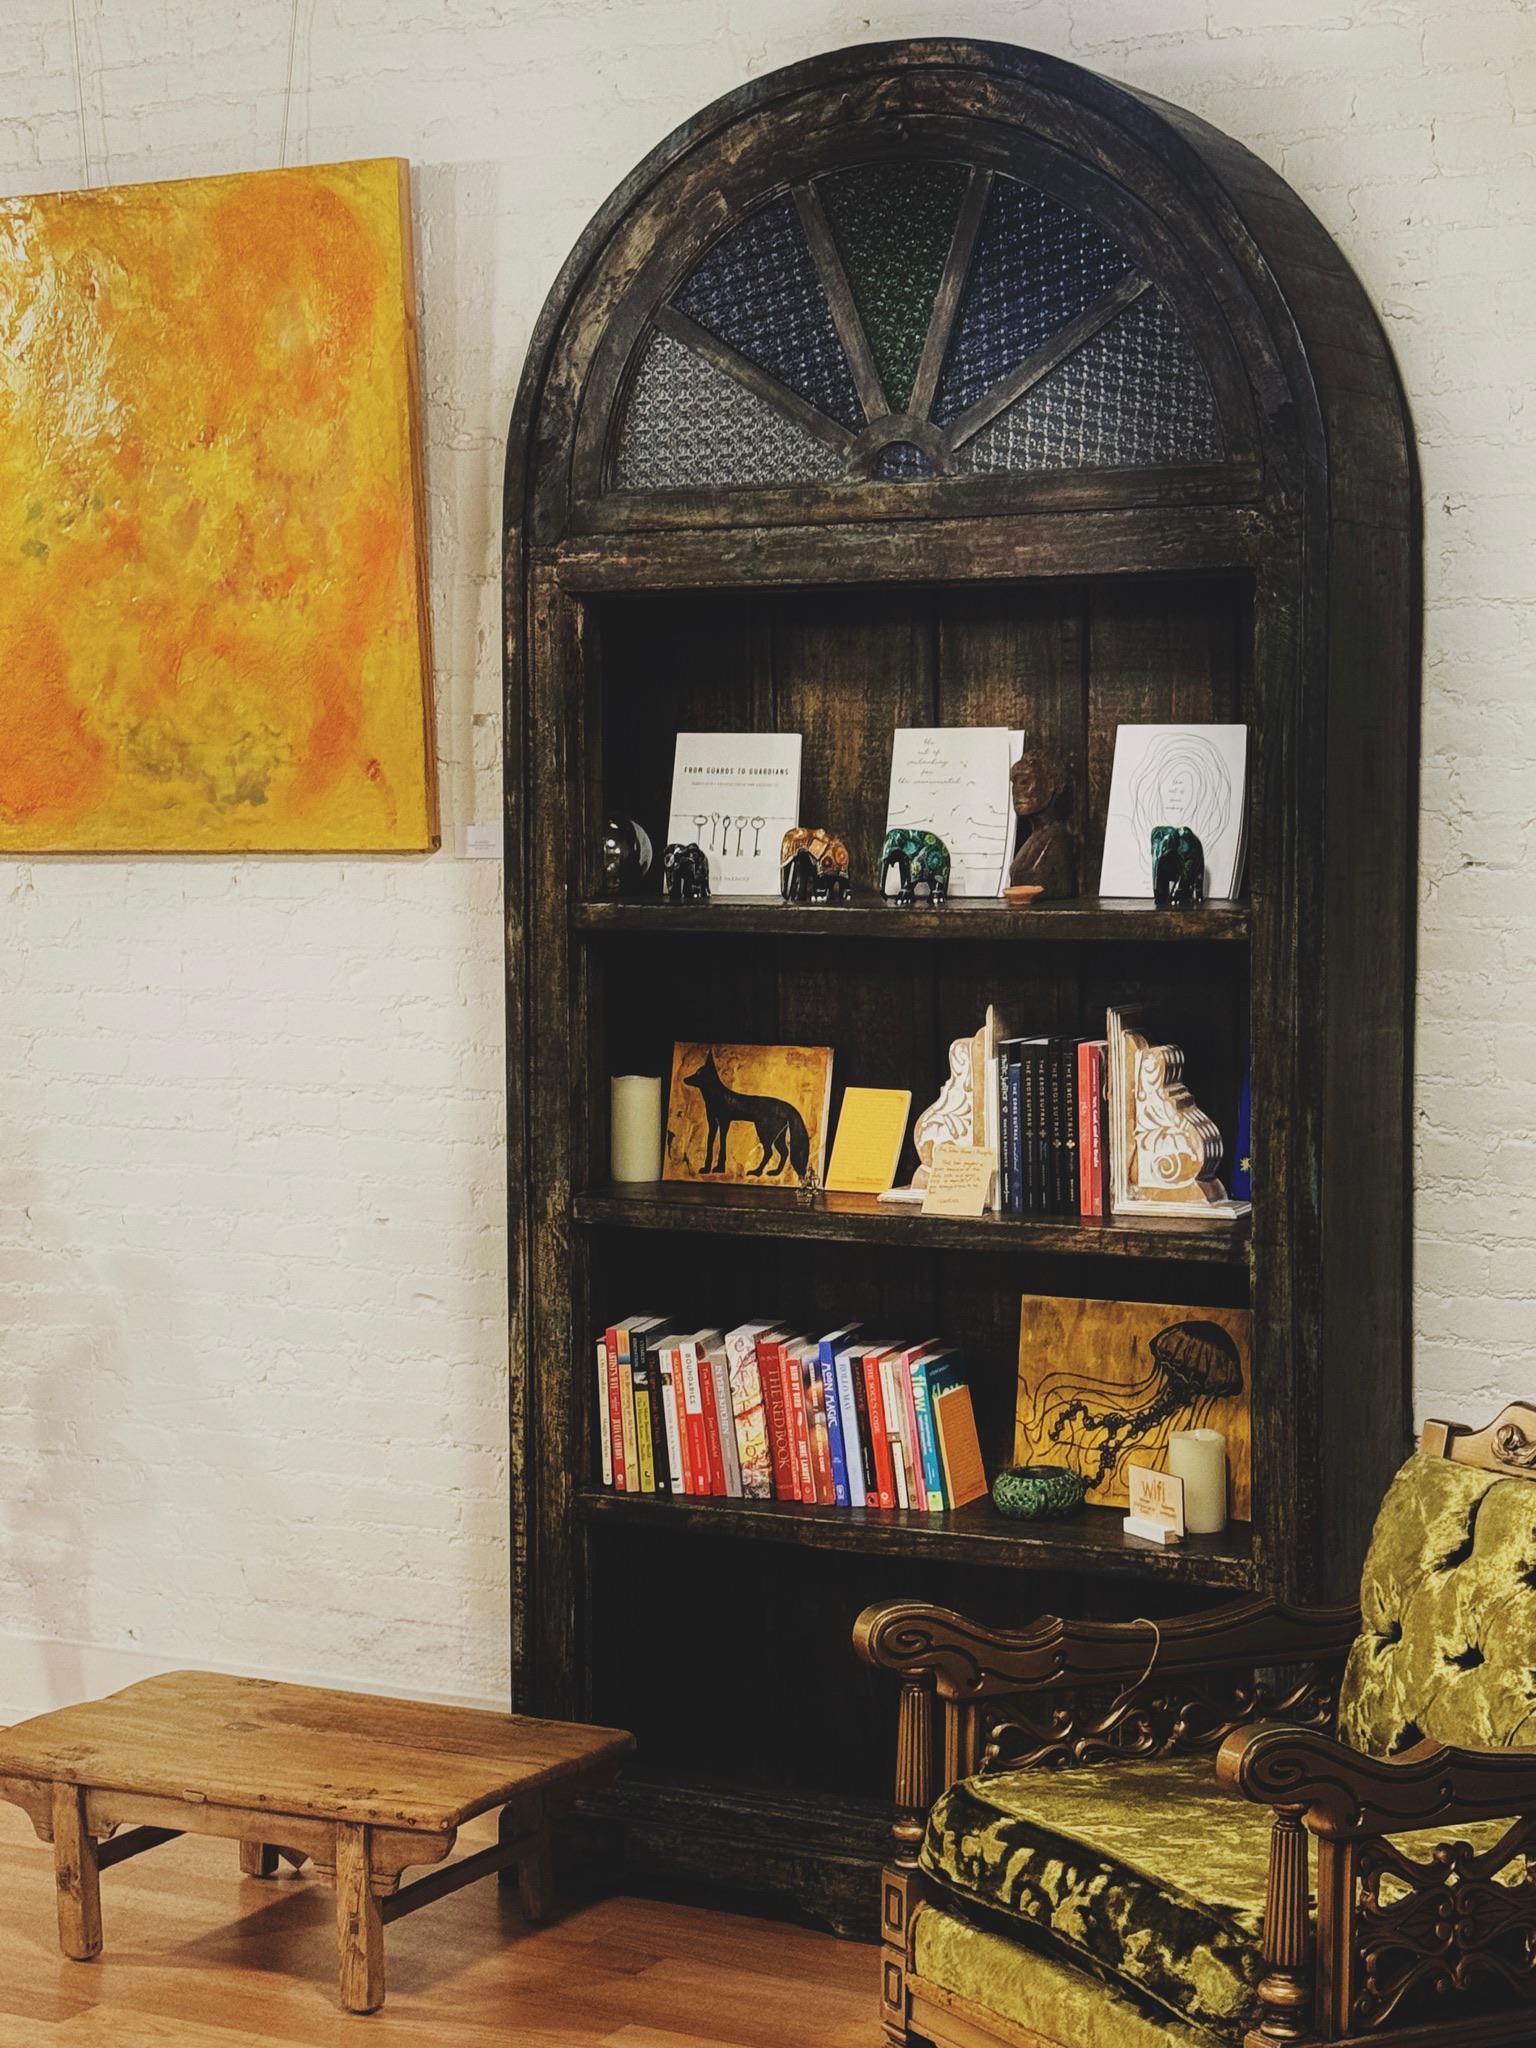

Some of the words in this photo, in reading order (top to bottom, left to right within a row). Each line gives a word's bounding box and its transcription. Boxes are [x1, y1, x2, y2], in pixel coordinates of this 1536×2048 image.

[684, 766, 703, 774] FROM
[706, 767, 734, 775] GUARDS
[738, 767, 746, 775] TO
[749, 768, 789, 776] GUARDIANS
[685, 1353, 695, 1404] BOUNDARIES
[769, 1369, 781, 1397] THE
[790, 1366, 799, 1381] BIRD
[822, 1362, 835, 1391] MOON
[839, 1364, 848, 1392] ROLLO
[866, 1363, 875, 1380] THE
[791, 1383, 800, 1392] BY
[793, 1392, 802, 1408] BIRD
[911, 1375, 928, 1412] flow
[719, 1398, 729, 1435] KITCHEN
[773, 1401, 784, 1429] RED
[825, 1394, 837, 1428] MAGIC
[775, 1431, 789, 1469] BOOK
[800, 1459, 811, 1483] LAMOTT
